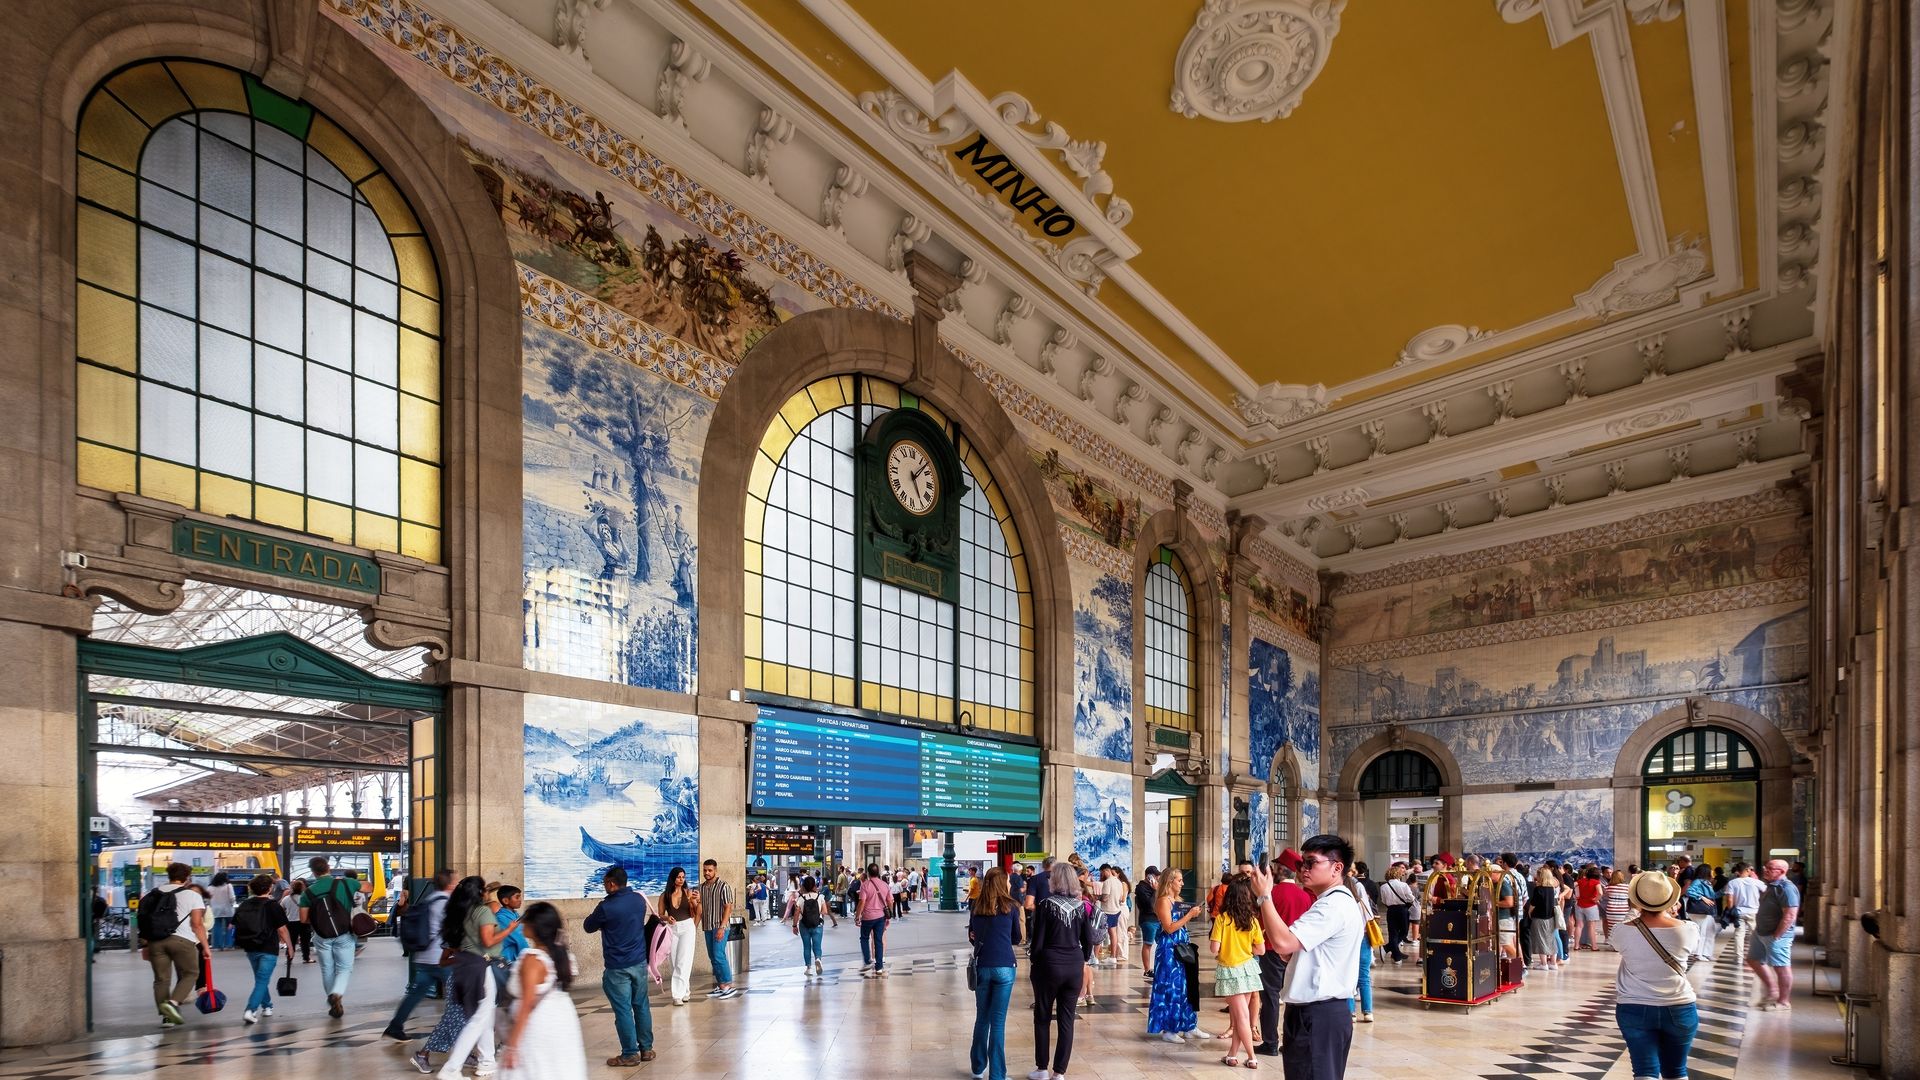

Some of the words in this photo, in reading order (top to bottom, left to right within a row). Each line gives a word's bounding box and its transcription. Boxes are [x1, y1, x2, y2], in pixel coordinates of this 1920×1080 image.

[954, 134, 1075, 236] MINHO
[192, 527, 365, 585] ENTRADA
[817, 717, 838, 726] PARTIDAS
[841, 721, 869, 730] DEPARTURES
[1662, 815, 1696, 823] CENTRO
[1697, 815, 1710, 823] DA
[1666, 822, 1727, 830] MOBILIDADE
